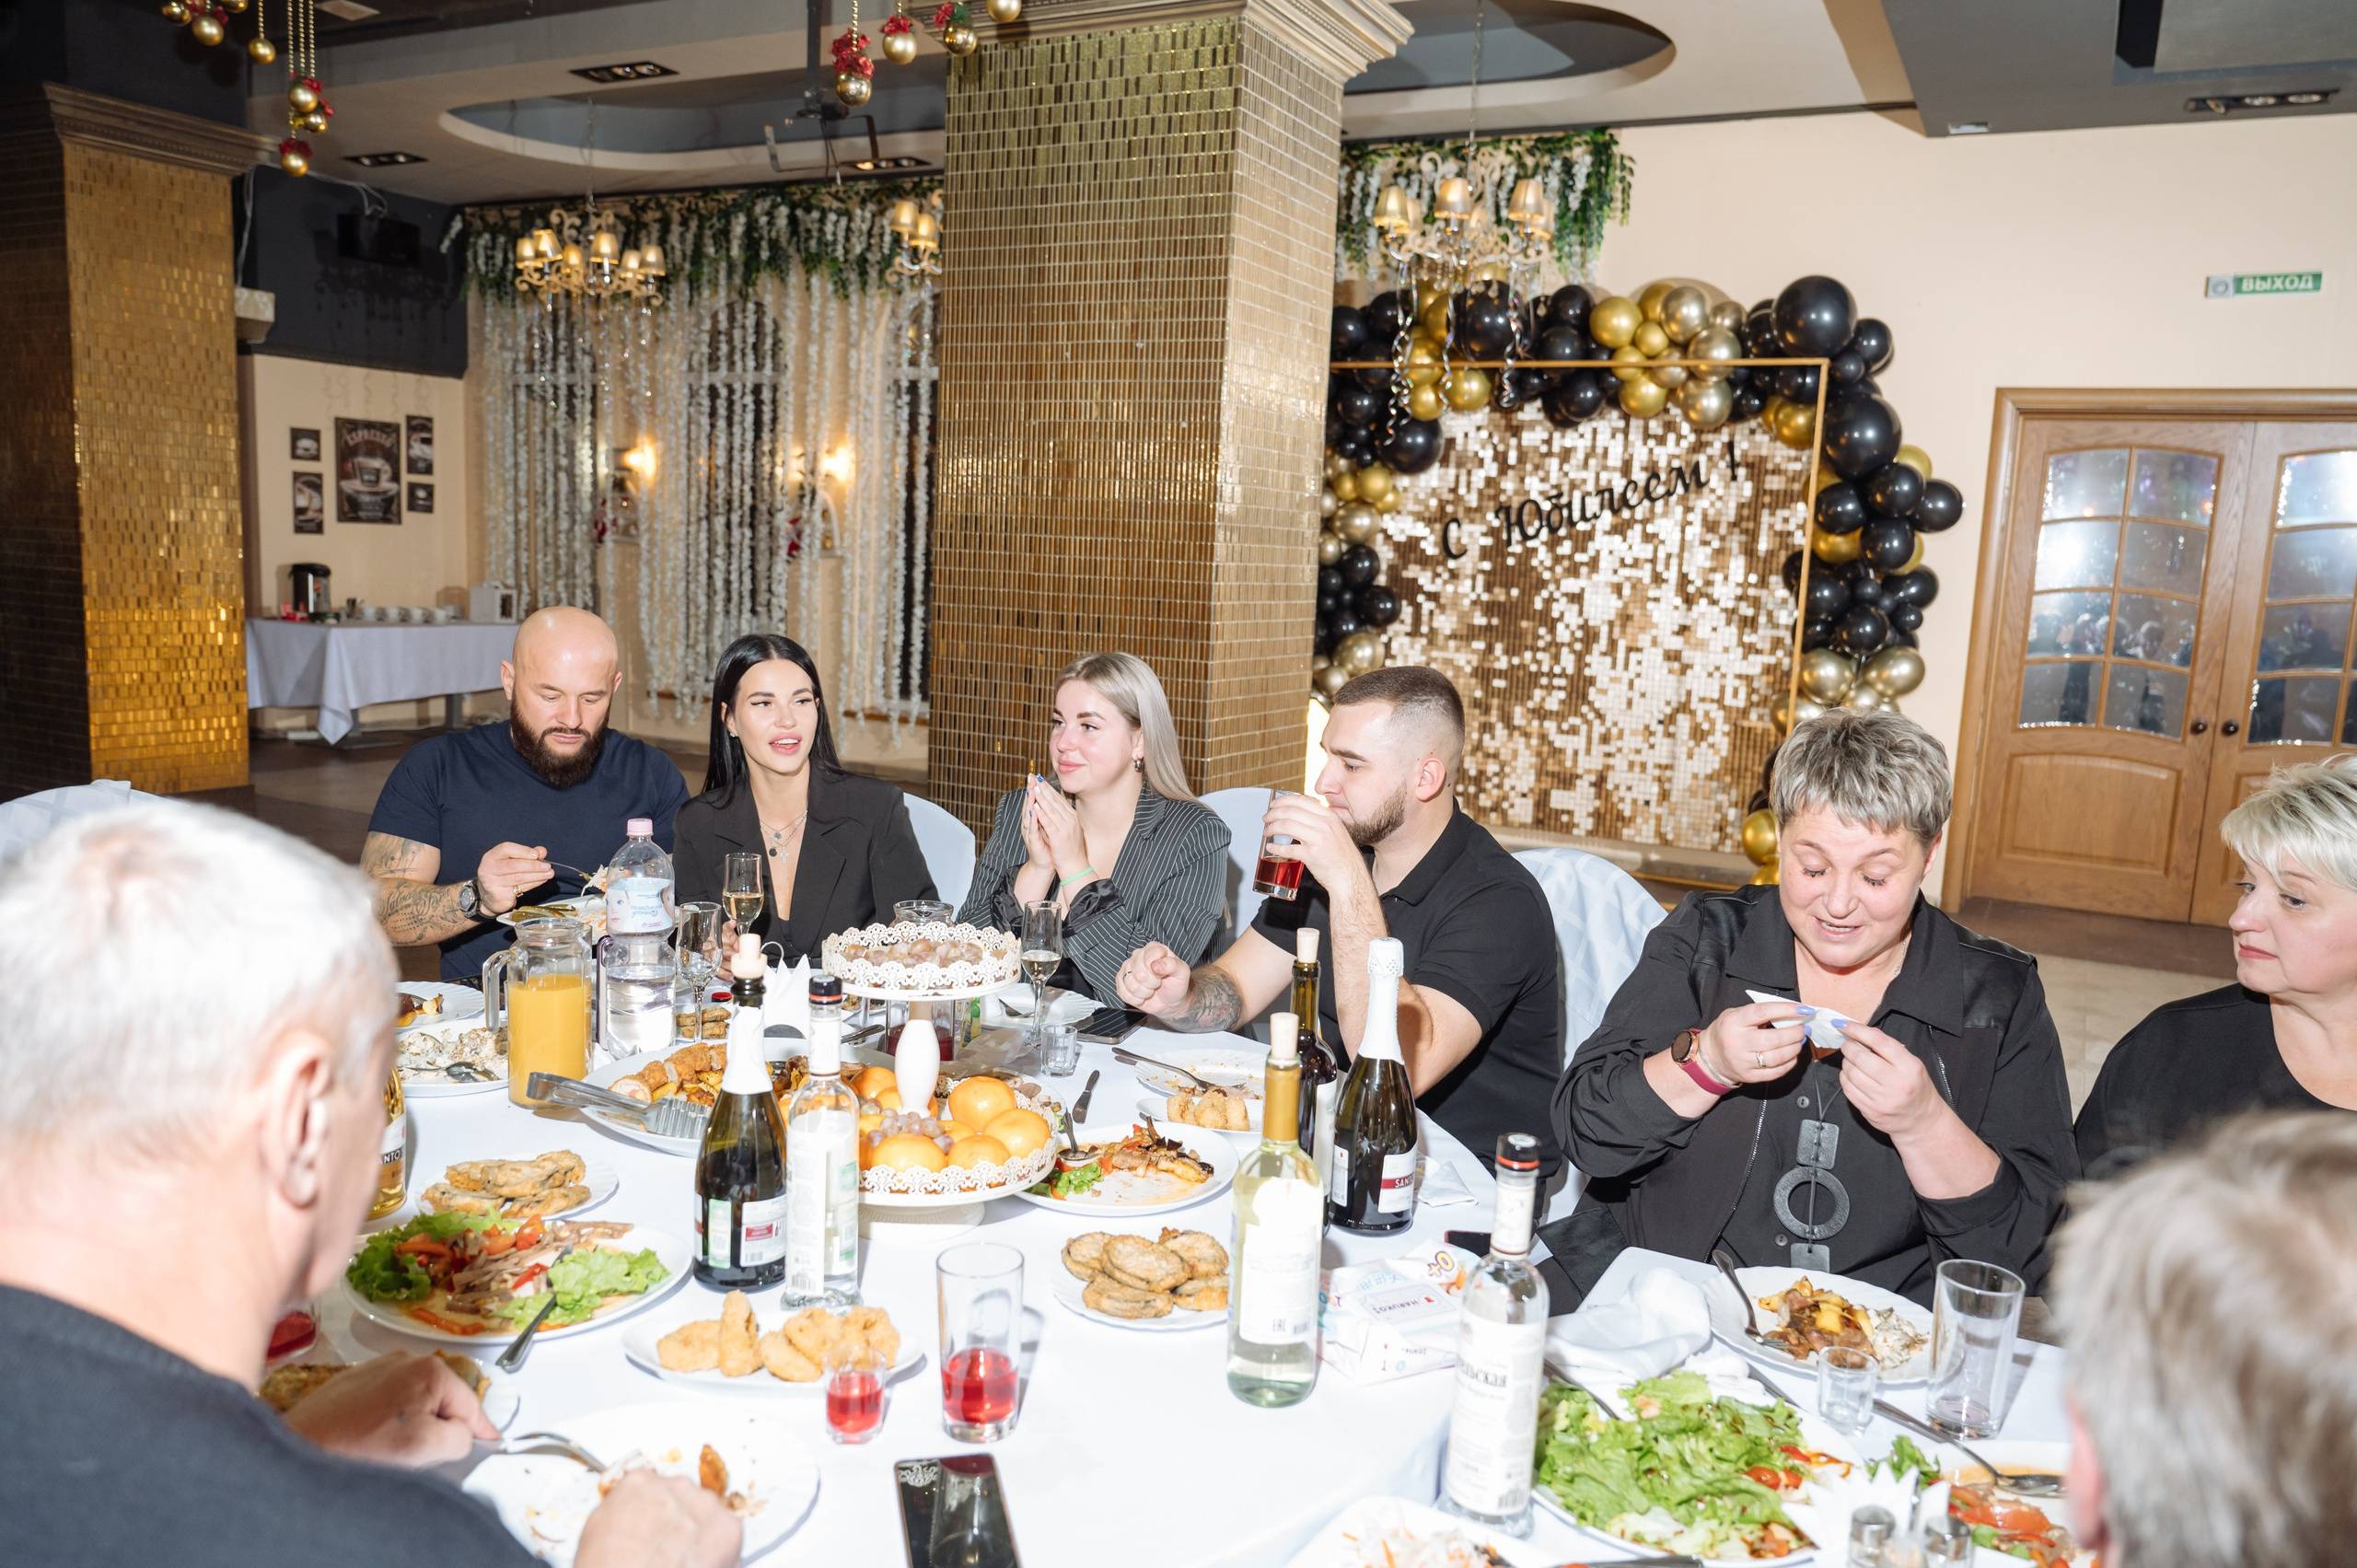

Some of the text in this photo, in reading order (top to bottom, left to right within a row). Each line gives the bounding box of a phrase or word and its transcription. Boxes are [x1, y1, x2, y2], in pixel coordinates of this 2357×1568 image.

[2241, 274, 2314, 292] ВЫХОД
[1442, 517, 1468, 561] С
[1495, 459, 1710, 547] Юбилеем
